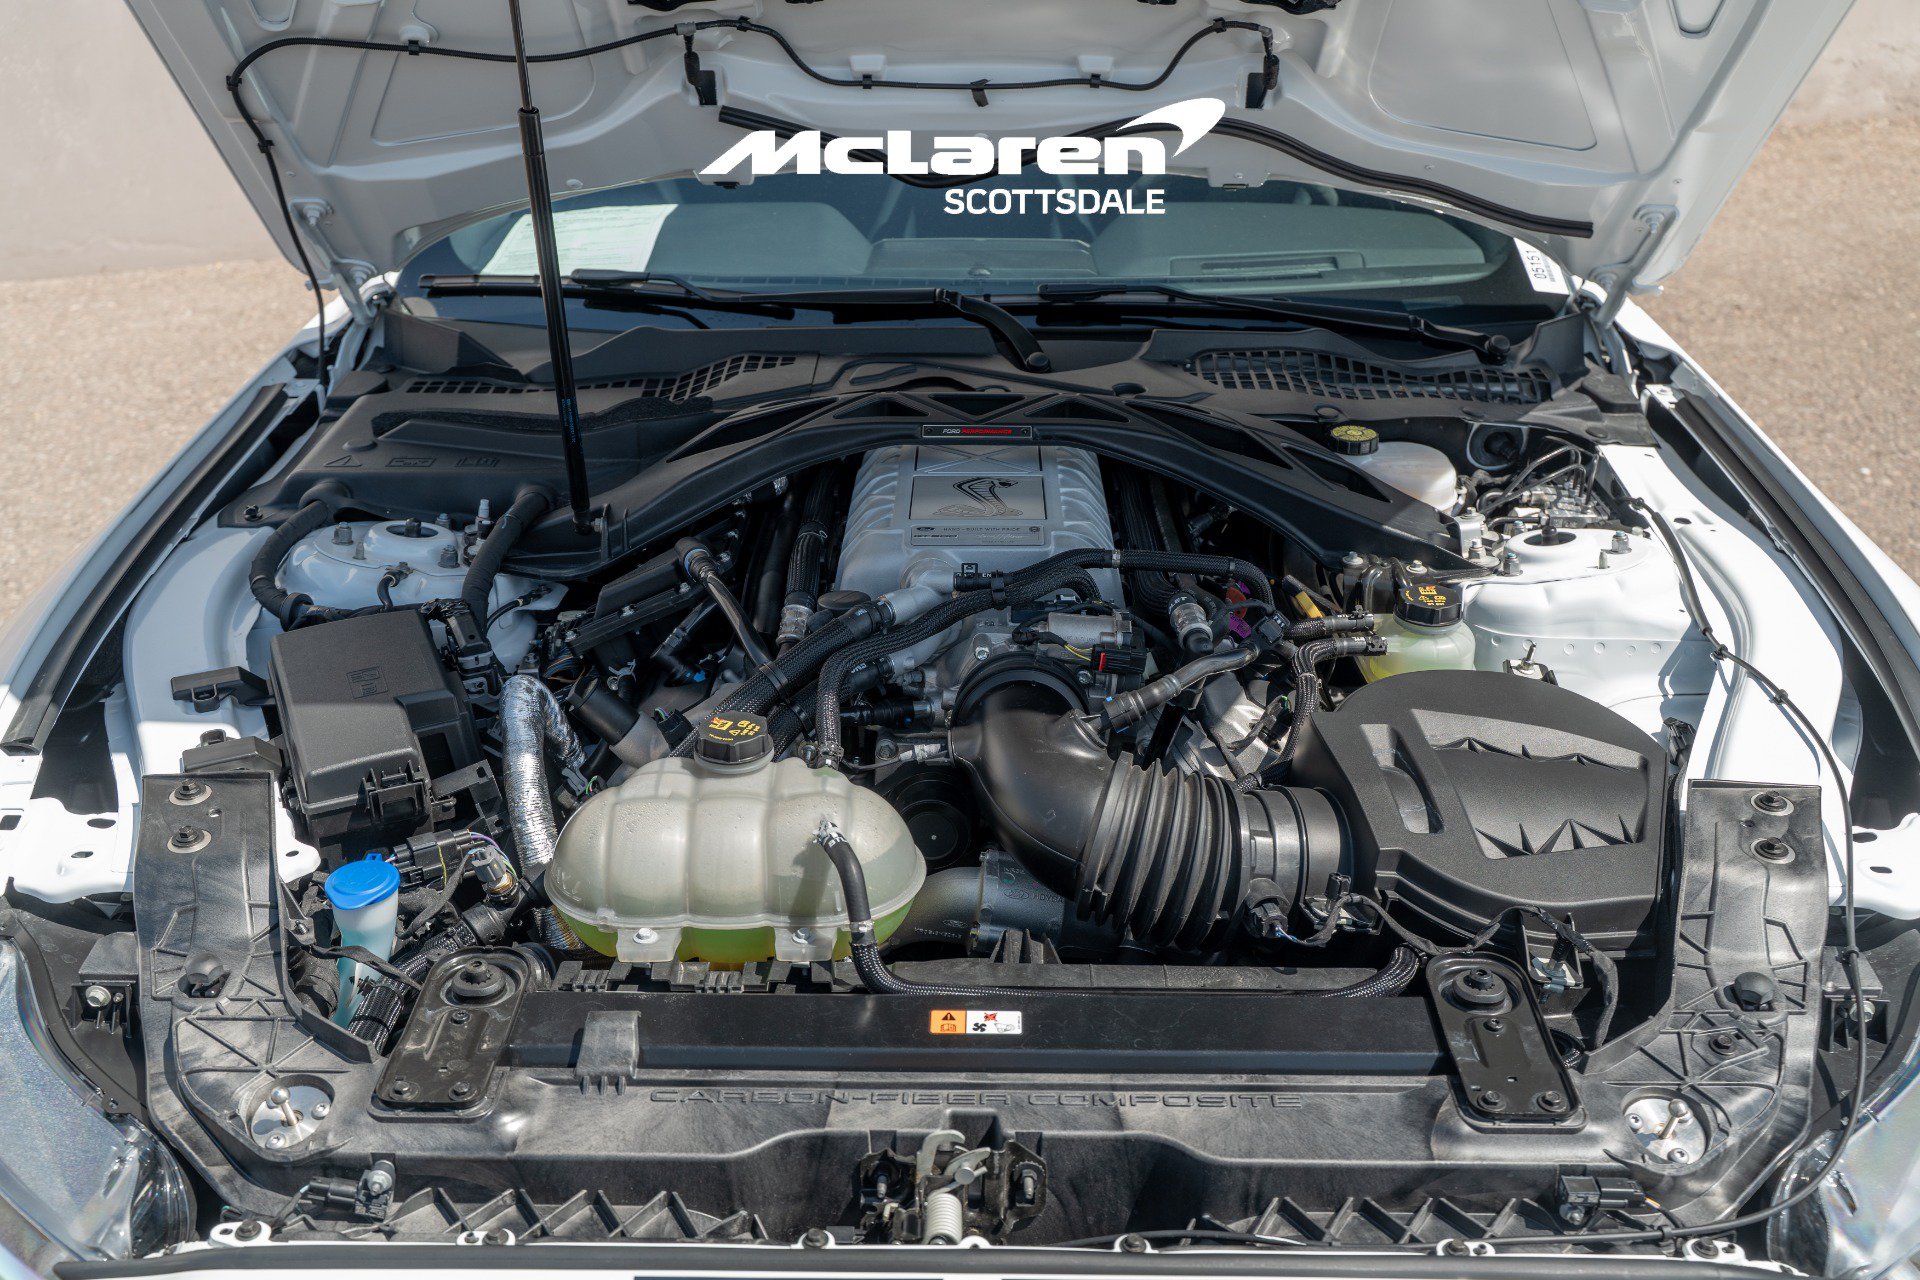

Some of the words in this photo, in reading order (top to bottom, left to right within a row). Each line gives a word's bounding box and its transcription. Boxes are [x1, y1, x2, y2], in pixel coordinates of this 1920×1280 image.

[1526, 250, 1548, 279] 05151
[650, 1090, 1010, 1105] CARBON-FIBER
[1028, 1093, 1302, 1108] COMPOSITE
